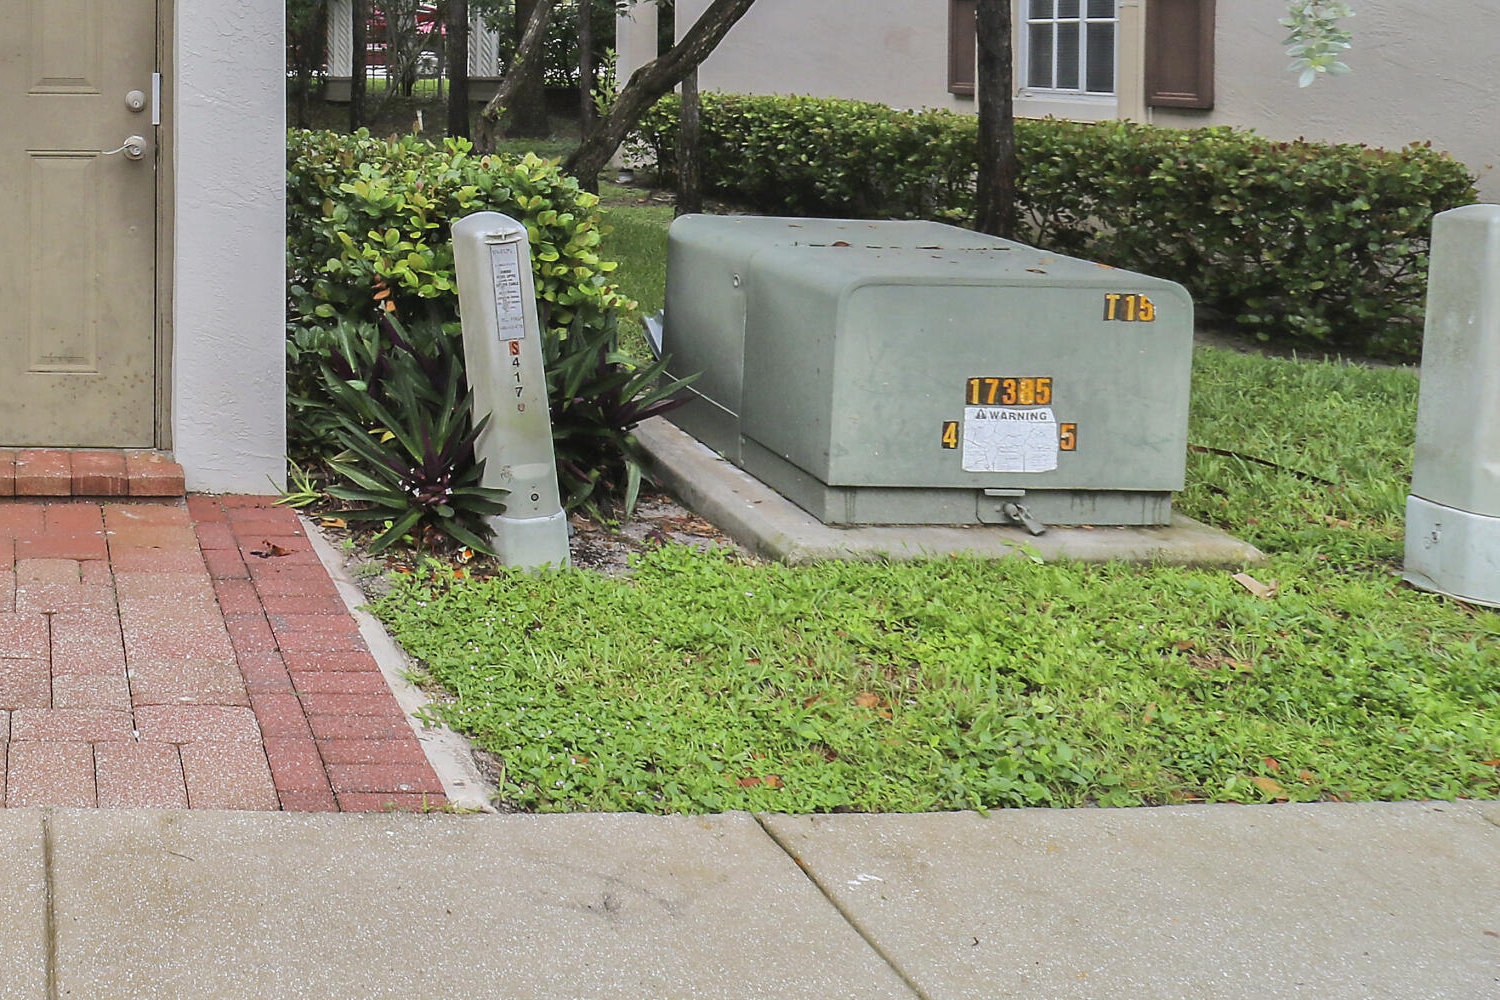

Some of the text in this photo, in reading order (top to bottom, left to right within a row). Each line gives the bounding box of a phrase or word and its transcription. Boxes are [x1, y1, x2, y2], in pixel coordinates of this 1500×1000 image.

[1105, 294, 1155, 321] T15
[989, 411, 1048, 420] WARNING
[942, 421, 957, 449] 4
[1060, 423, 1076, 450] 5
